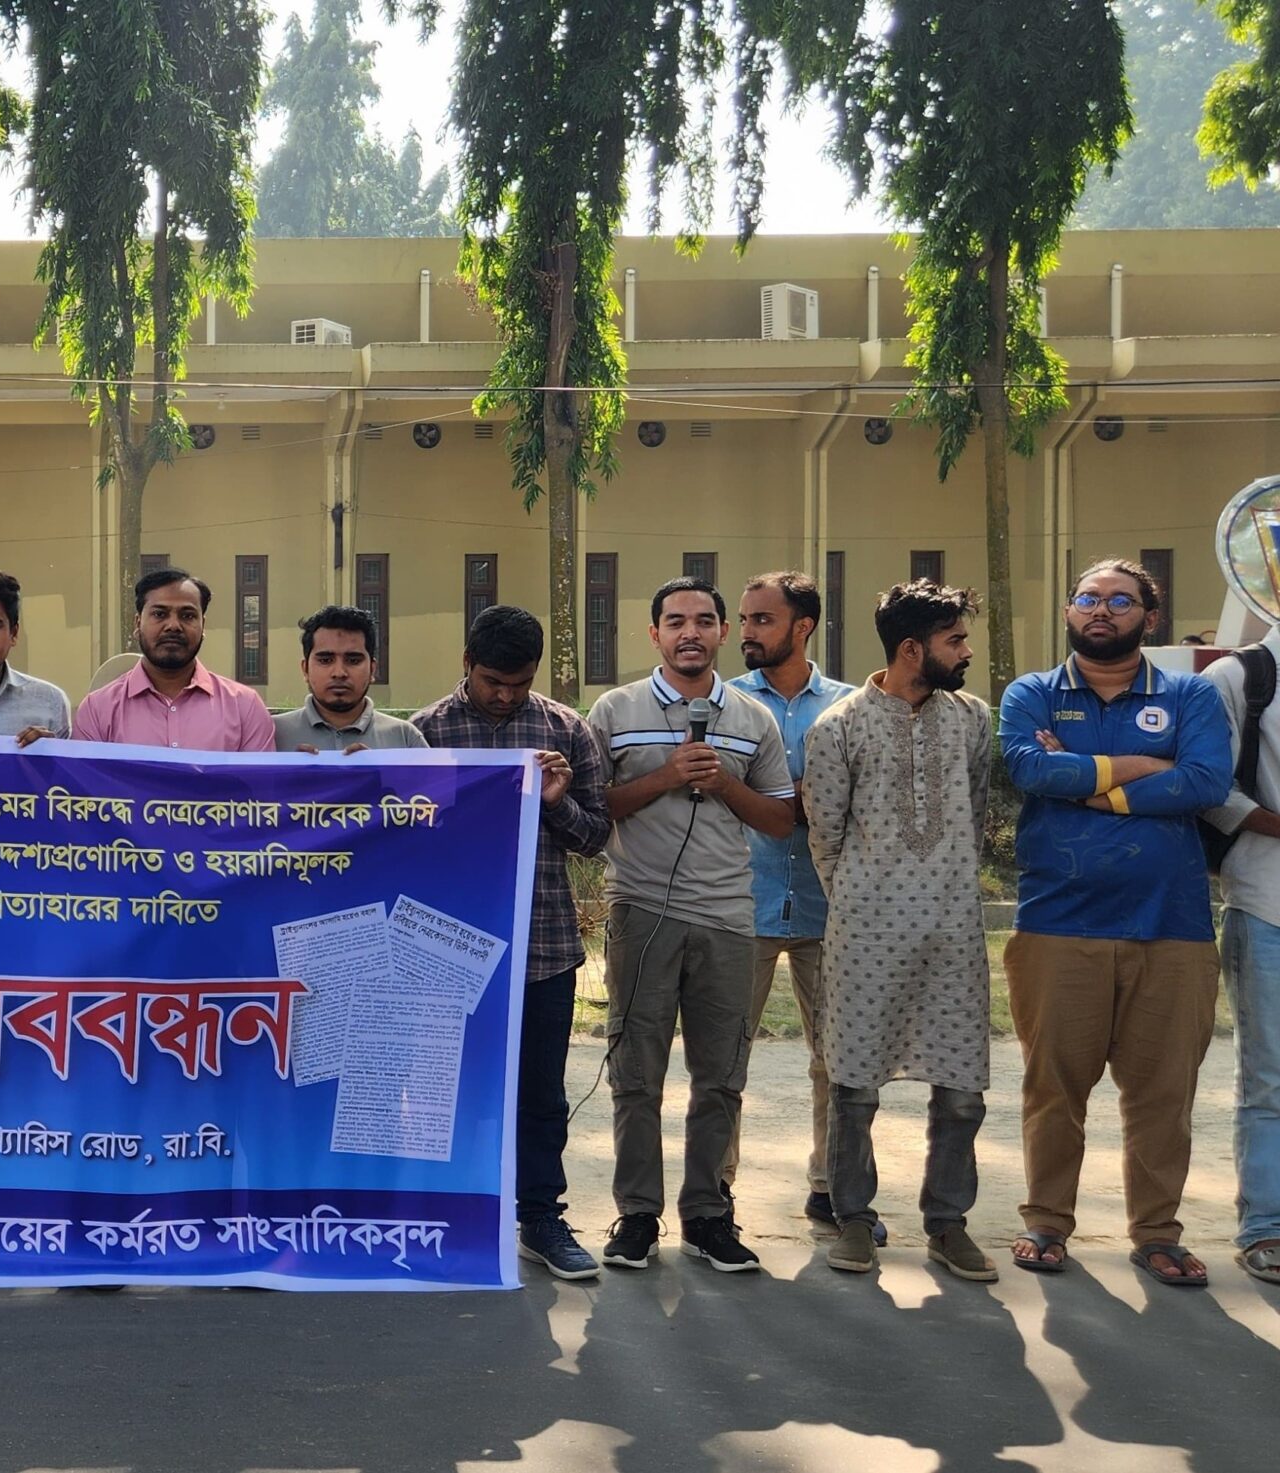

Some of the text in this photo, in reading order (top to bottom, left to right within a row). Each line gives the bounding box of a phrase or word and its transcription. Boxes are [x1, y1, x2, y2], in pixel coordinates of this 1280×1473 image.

[45, 786, 135, 825] বিরুদ্ধে
[143, 799, 281, 828] নেত্রকোণার
[287, 802, 374, 829] সাবেক
[379, 795, 439, 828] ডিসি
[173, 852, 195, 873] ও
[203, 843, 354, 884] হয়রানিমূলক
[128, 890, 222, 924] দাবিতে
[161, 1122, 231, 1159] রা.বি.
[81, 1208, 206, 1257] কর্মরত
[213, 1204, 450, 1271] সাংবাদিকবৃন্দ
